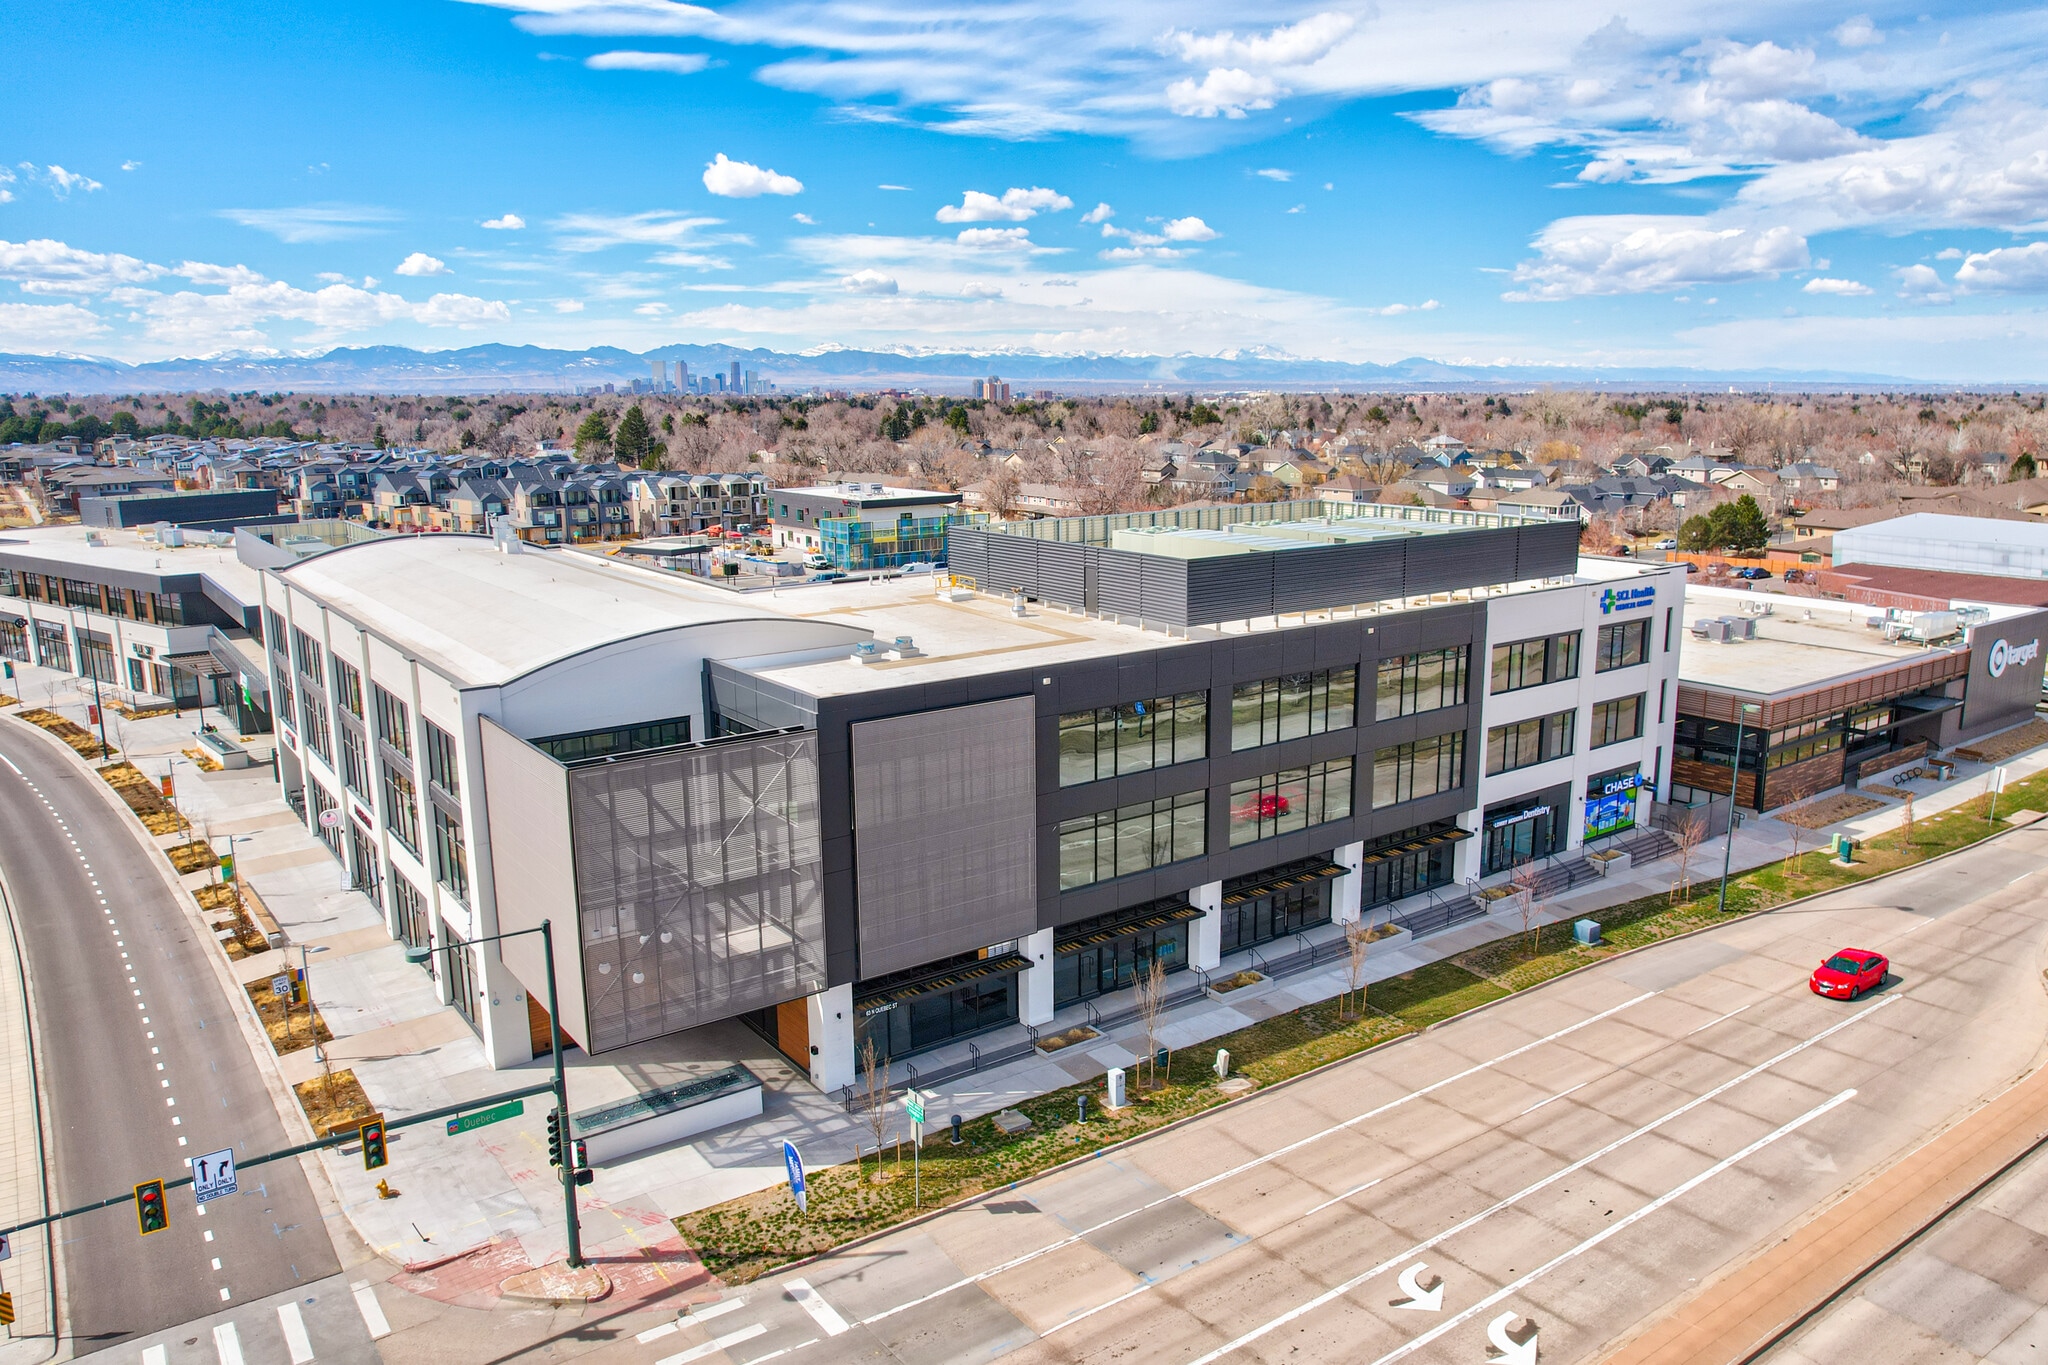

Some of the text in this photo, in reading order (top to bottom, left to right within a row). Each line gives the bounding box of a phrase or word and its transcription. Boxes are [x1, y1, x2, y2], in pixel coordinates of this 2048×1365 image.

[1616, 586, 1655, 601] SCL Health
[2007, 638, 2039, 666] target
[1605, 777, 1634, 794] CHASE
[1524, 805, 1550, 819] Dentistry
[275, 985, 288, 994] 30
[464, 1113, 496, 1129] Quebec
[198, 1182, 213, 1192] ONLY
[218, 1176, 233, 1186] ONLY
